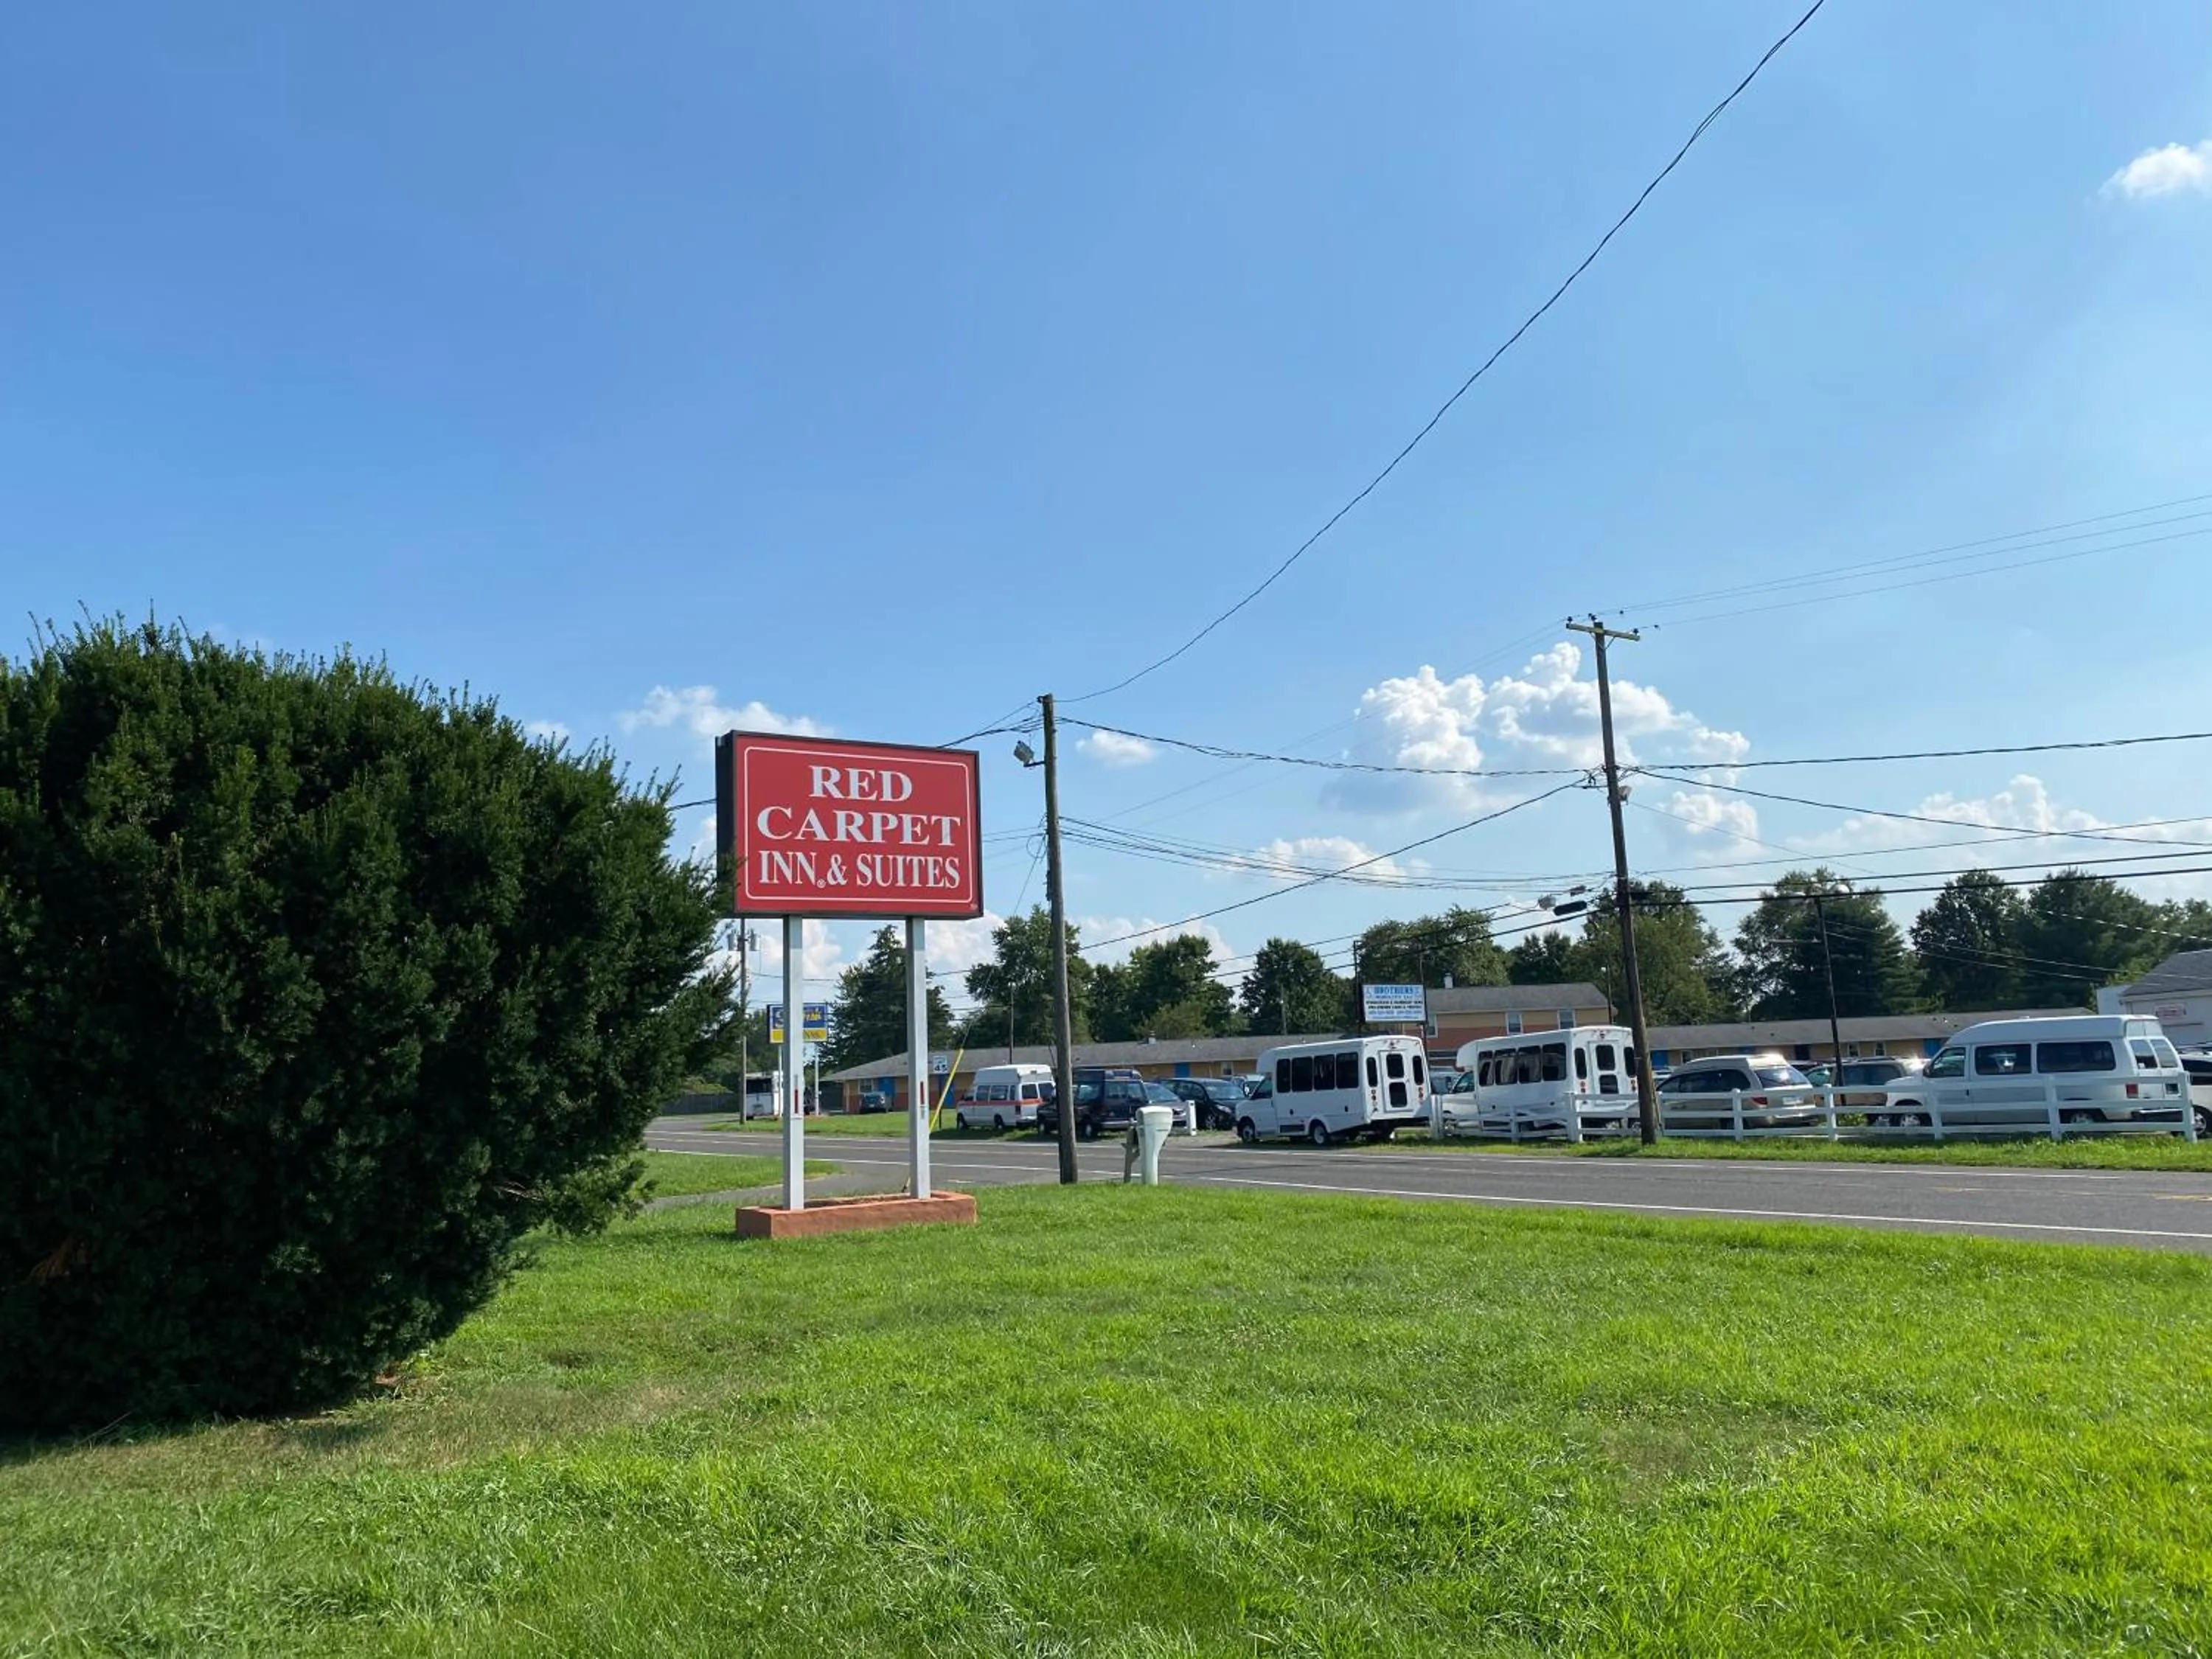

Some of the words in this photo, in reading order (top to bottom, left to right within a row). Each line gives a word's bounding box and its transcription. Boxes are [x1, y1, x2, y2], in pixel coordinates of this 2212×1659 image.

[808, 765, 913, 802] RED
[757, 805, 961, 846] CARPET
[827, 853, 848, 886] &
[855, 853, 960, 889] SUITES
